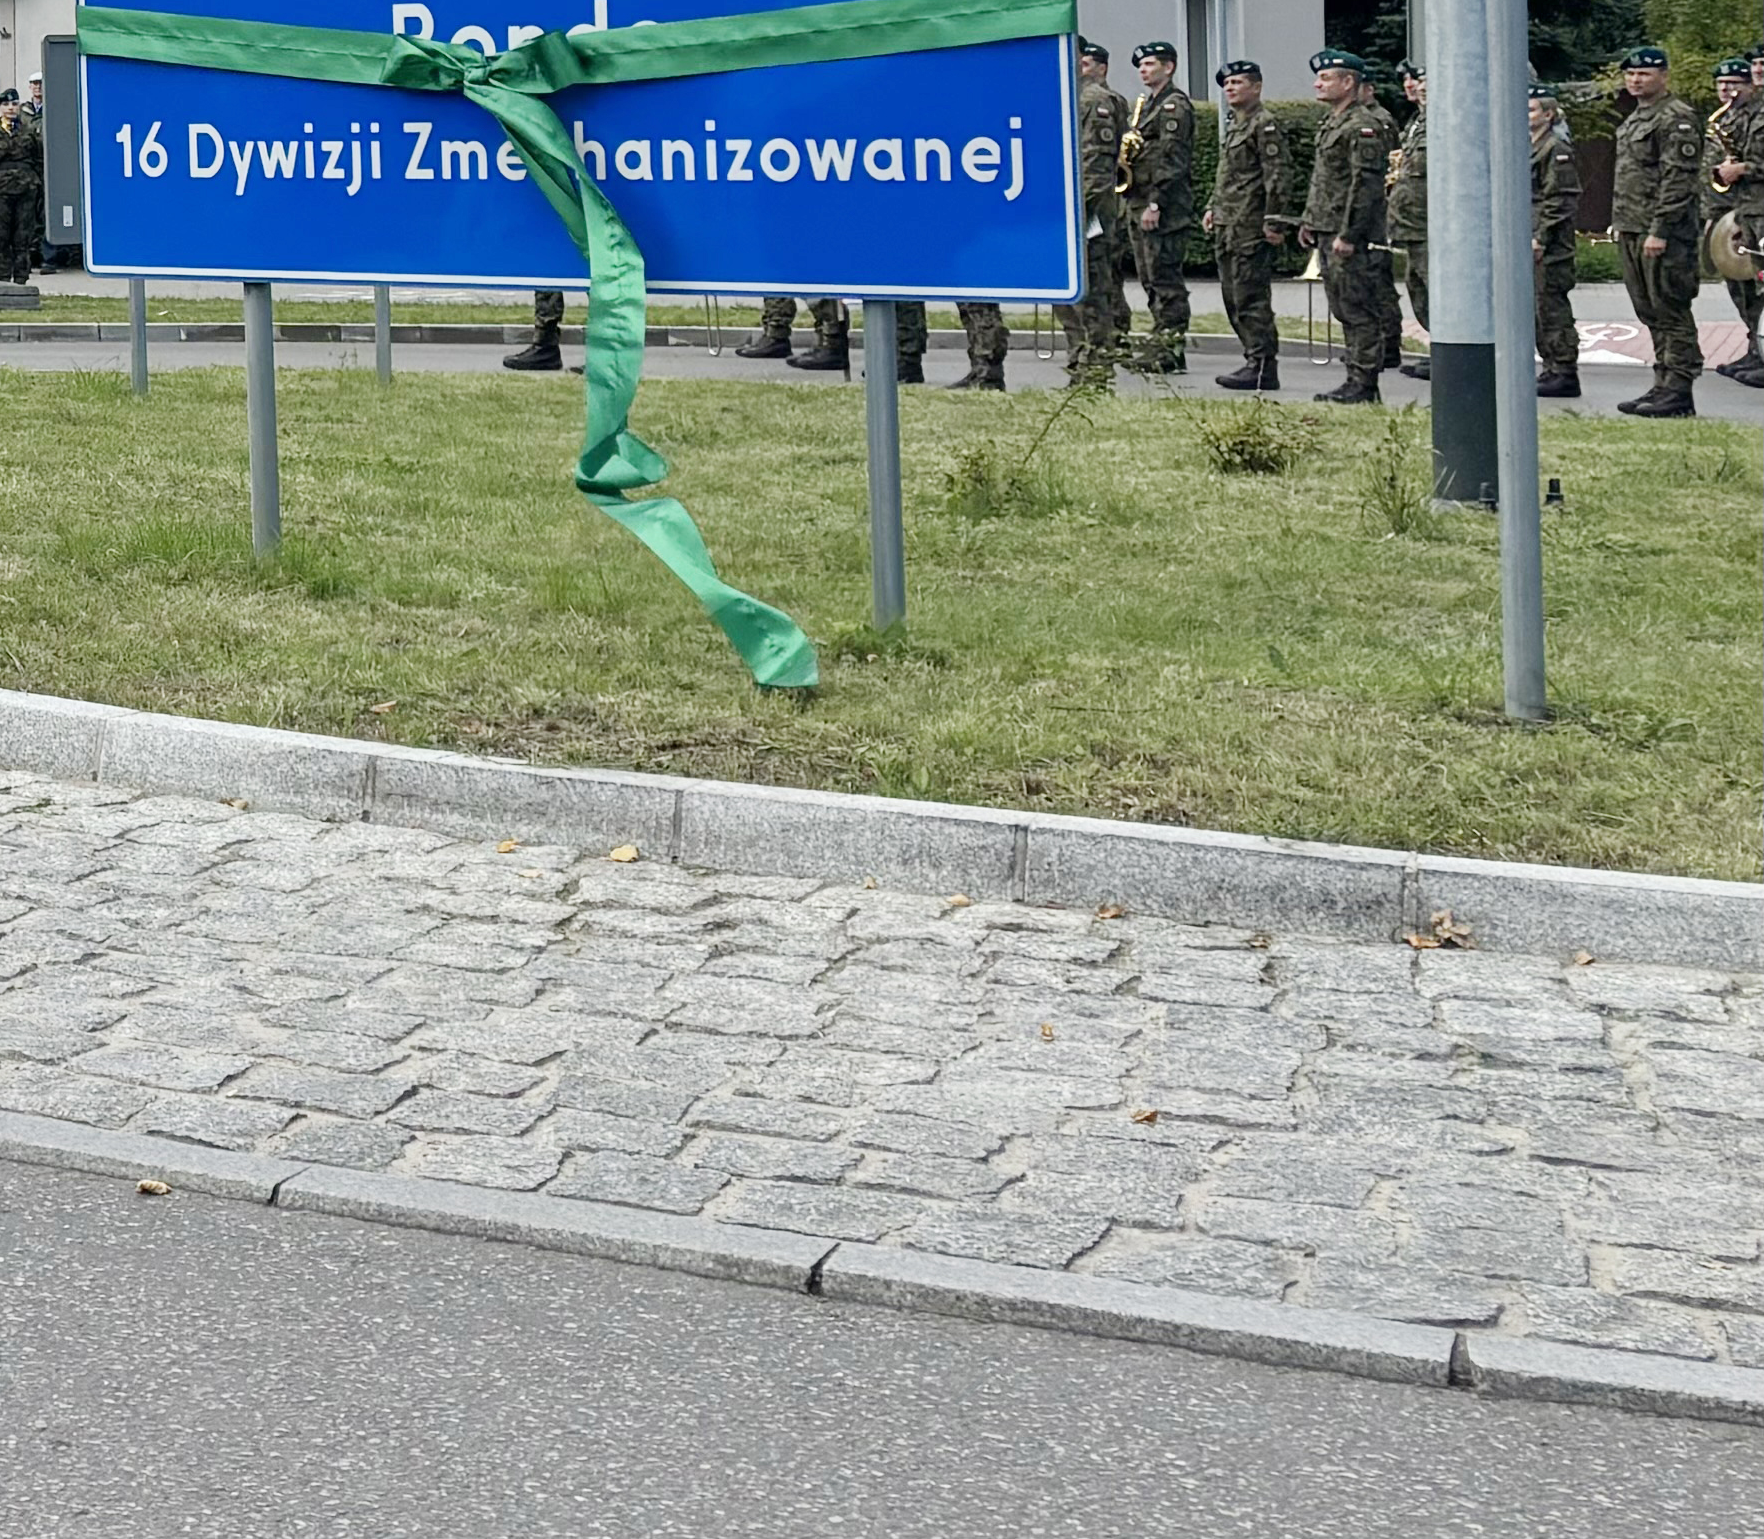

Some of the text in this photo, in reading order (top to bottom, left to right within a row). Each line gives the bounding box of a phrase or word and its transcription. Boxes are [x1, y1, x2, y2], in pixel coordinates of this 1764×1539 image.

[116, 116, 1025, 201] 16 Dywizji Zmehanizowanej
